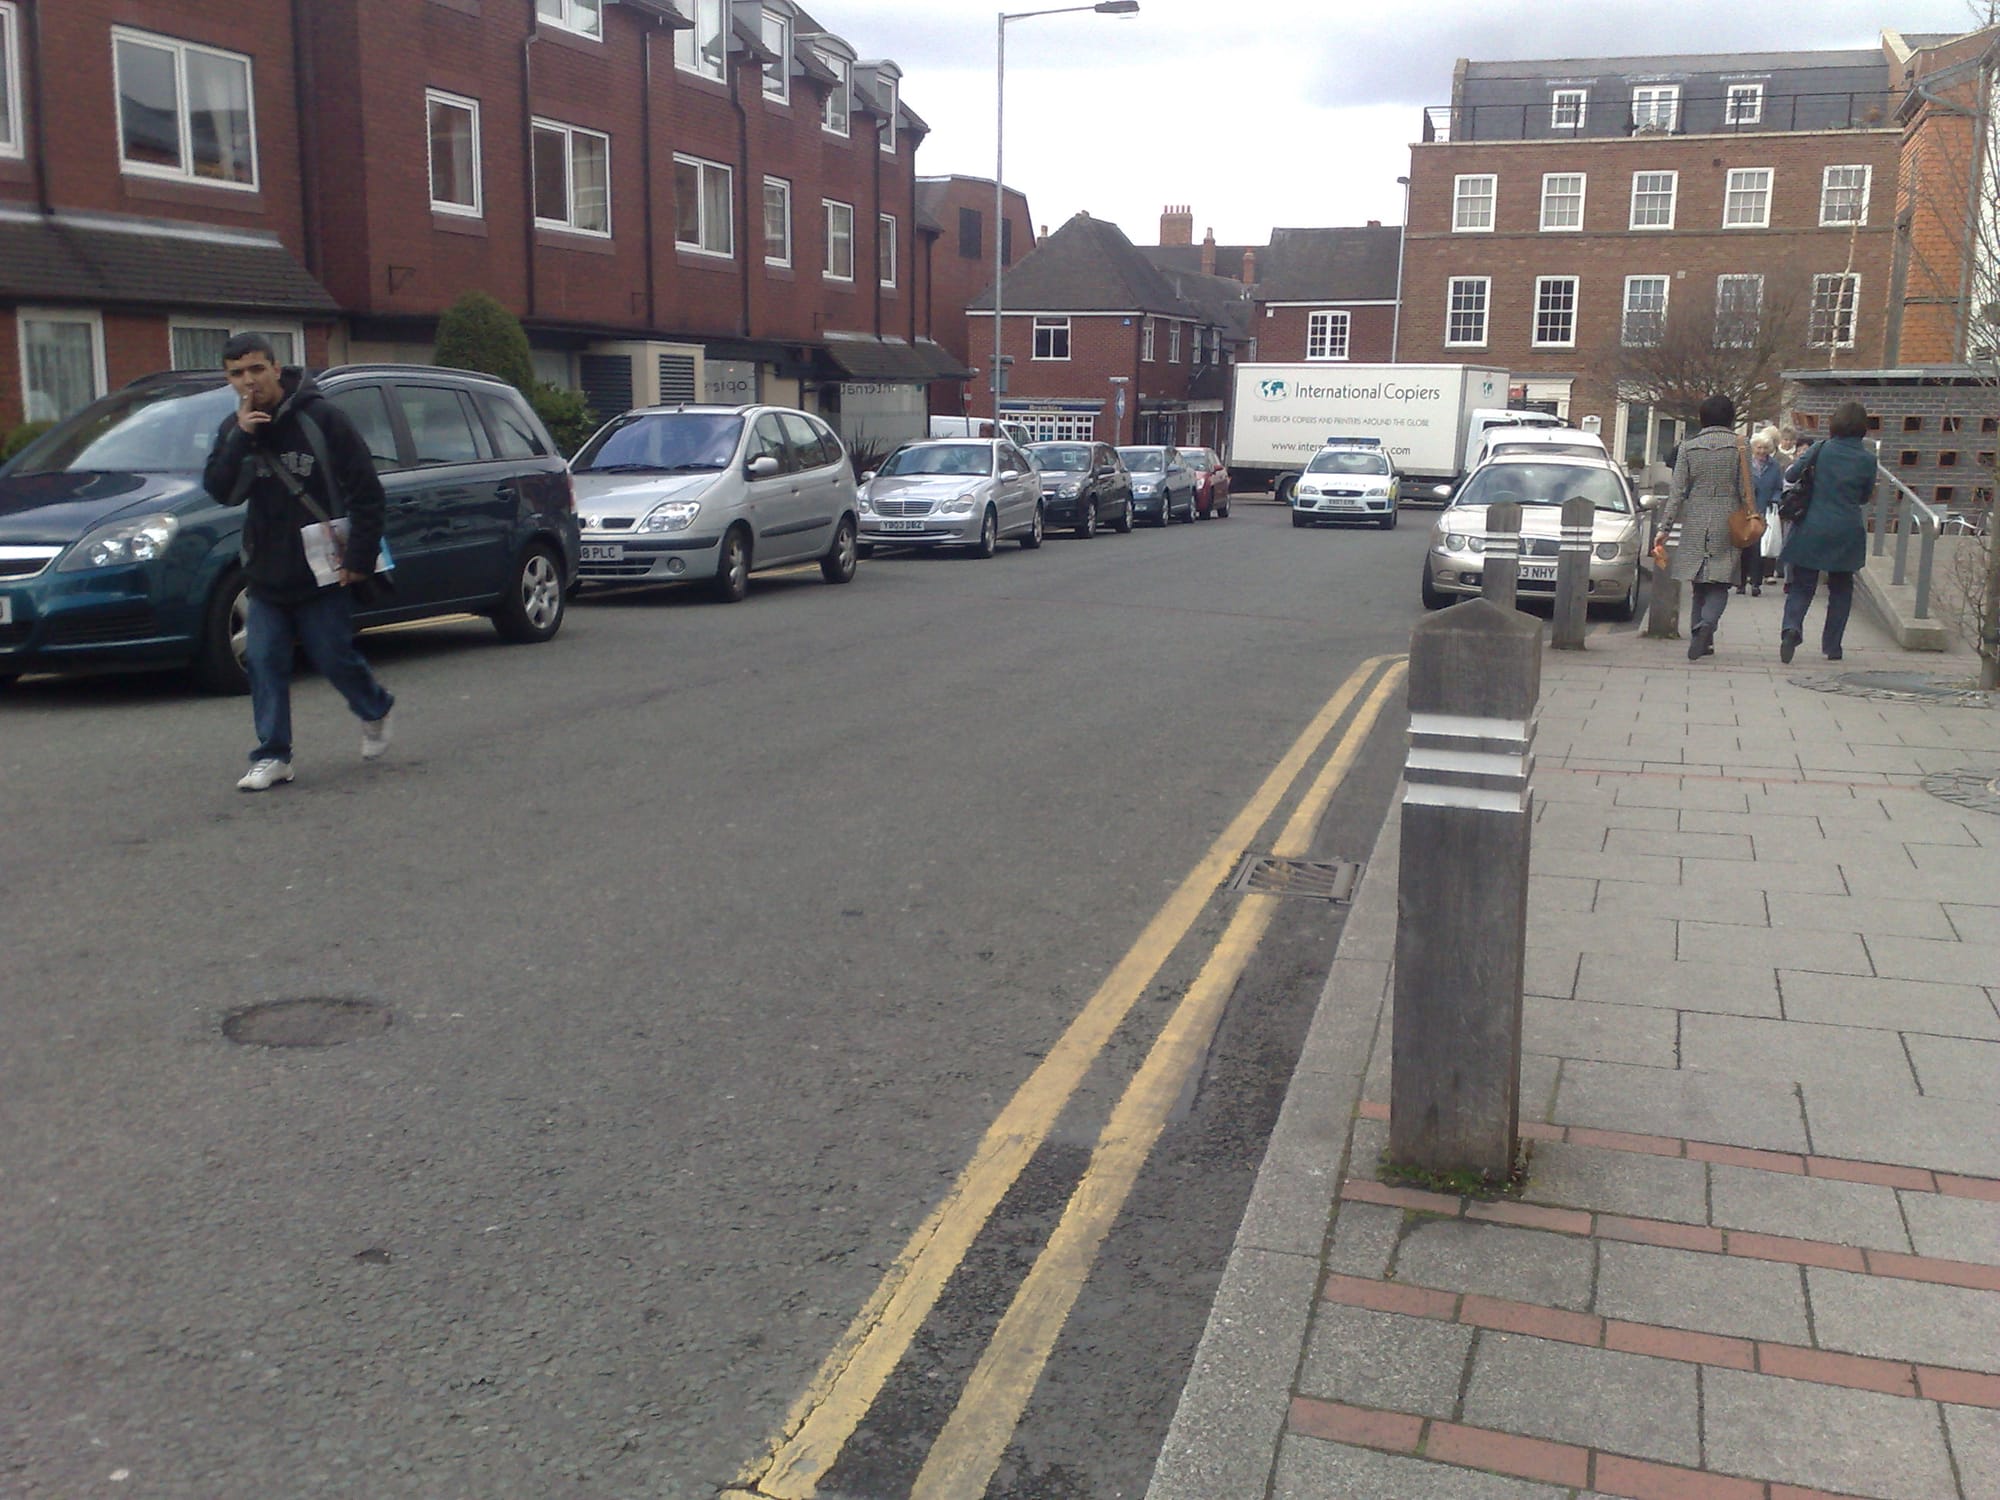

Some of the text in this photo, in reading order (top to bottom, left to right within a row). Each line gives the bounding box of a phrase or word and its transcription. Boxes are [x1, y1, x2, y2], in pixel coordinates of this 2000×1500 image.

[1295, 382, 1441, 404] International Copiers
[1253, 415, 1281, 423] SUPPLIERS
[1292, 416, 1317, 424] COPIERS
[1318, 417, 1333, 425] AND
[1362, 417, 1392, 426] AROUND
[1393, 418, 1405, 426] THE
[1406, 418, 1429, 427] GLOBE
[592, 547, 616, 559] PLC
[1532, 567, 1555, 579] NHY
